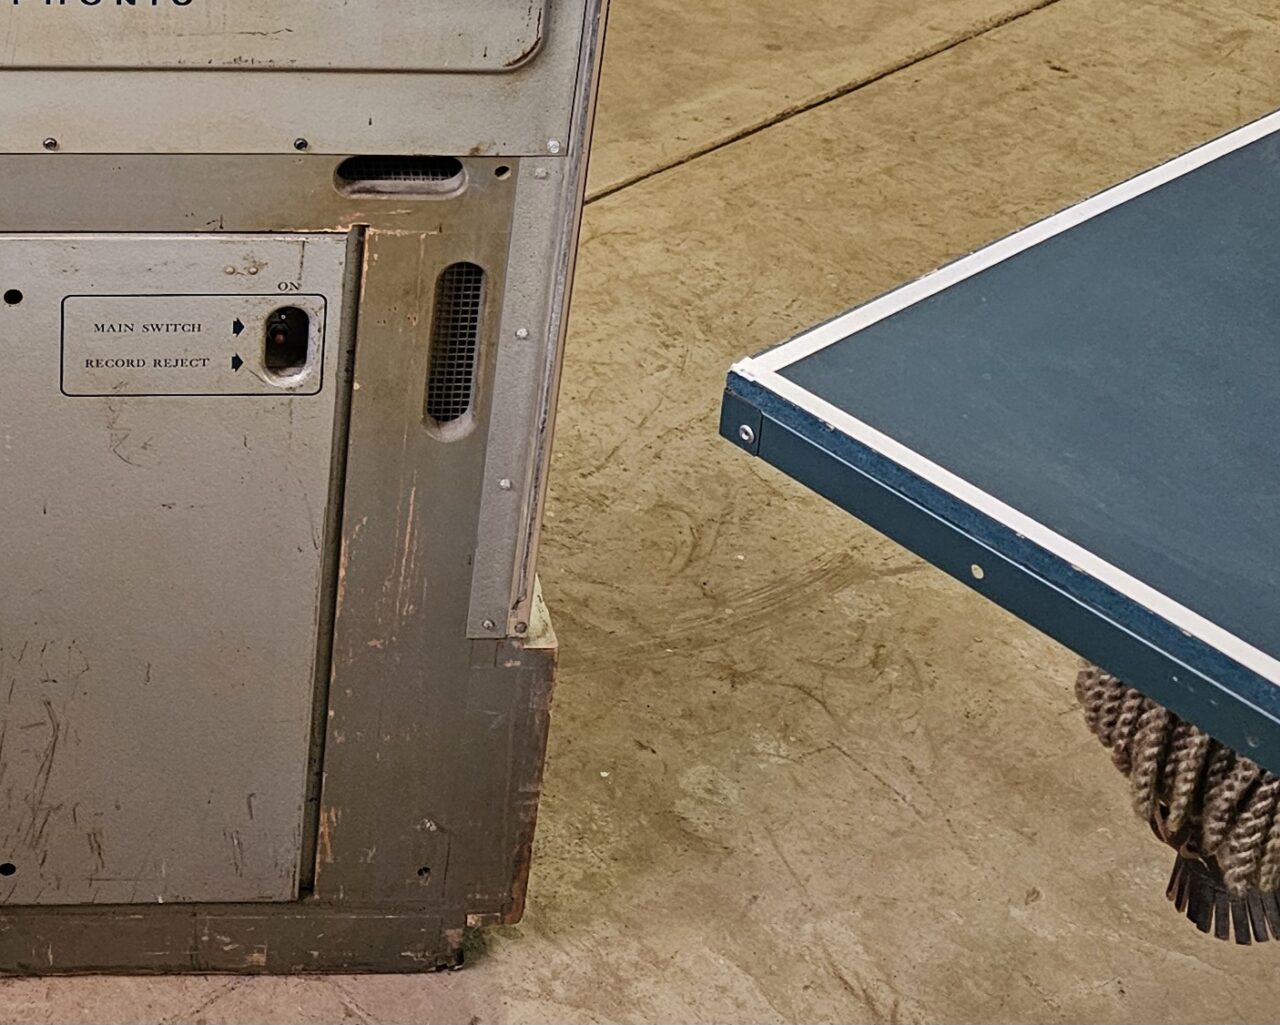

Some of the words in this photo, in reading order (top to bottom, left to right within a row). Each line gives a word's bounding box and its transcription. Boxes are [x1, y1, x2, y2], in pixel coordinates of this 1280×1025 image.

[277, 281, 302, 291] ON
[93, 323, 135, 333] MAIN
[141, 323, 202, 333] SWITCH
[85, 358, 152, 368] RECORD
[153, 358, 210, 368] REJECT
